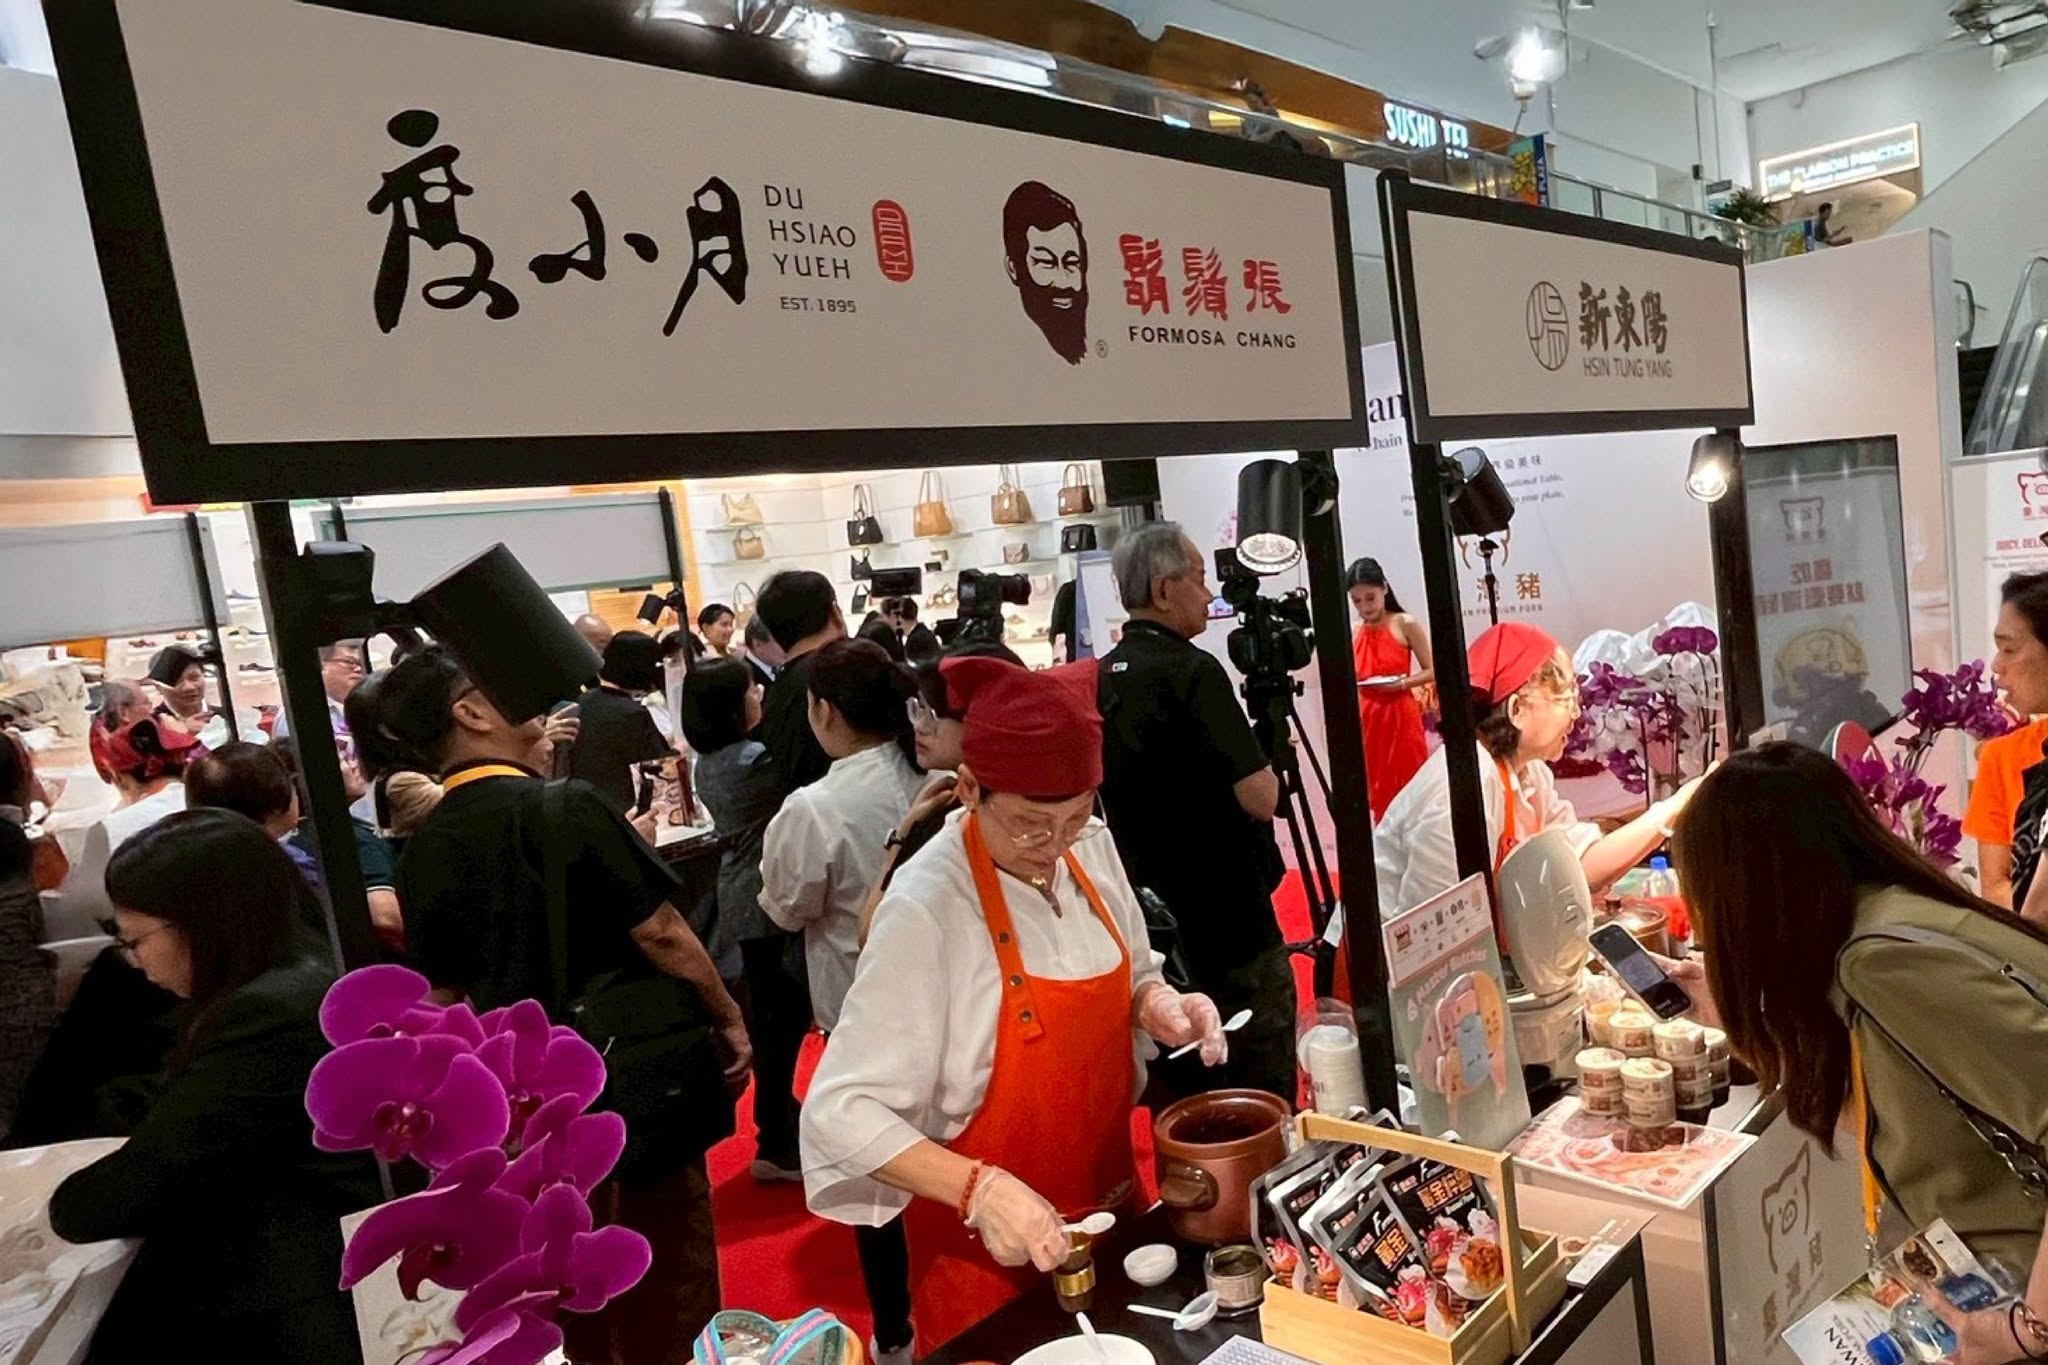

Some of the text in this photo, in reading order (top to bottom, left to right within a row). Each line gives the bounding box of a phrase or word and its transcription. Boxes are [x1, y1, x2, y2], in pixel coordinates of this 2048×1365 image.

[1384, 102, 1437, 148] SUSHI
[764, 185, 803, 210] DU
[367, 109, 748, 337] 度小月
[769, 219, 856, 248] HSIAO
[773, 253, 850, 279] YUEH
[1119, 233, 1291, 321] 鬍鬚張
[1578, 280, 1667, 354] 新東陽
[1129, 325, 1296, 349] FORMOSA CHANG
[1582, 357, 1672, 378] HSIN TUNG YANG
